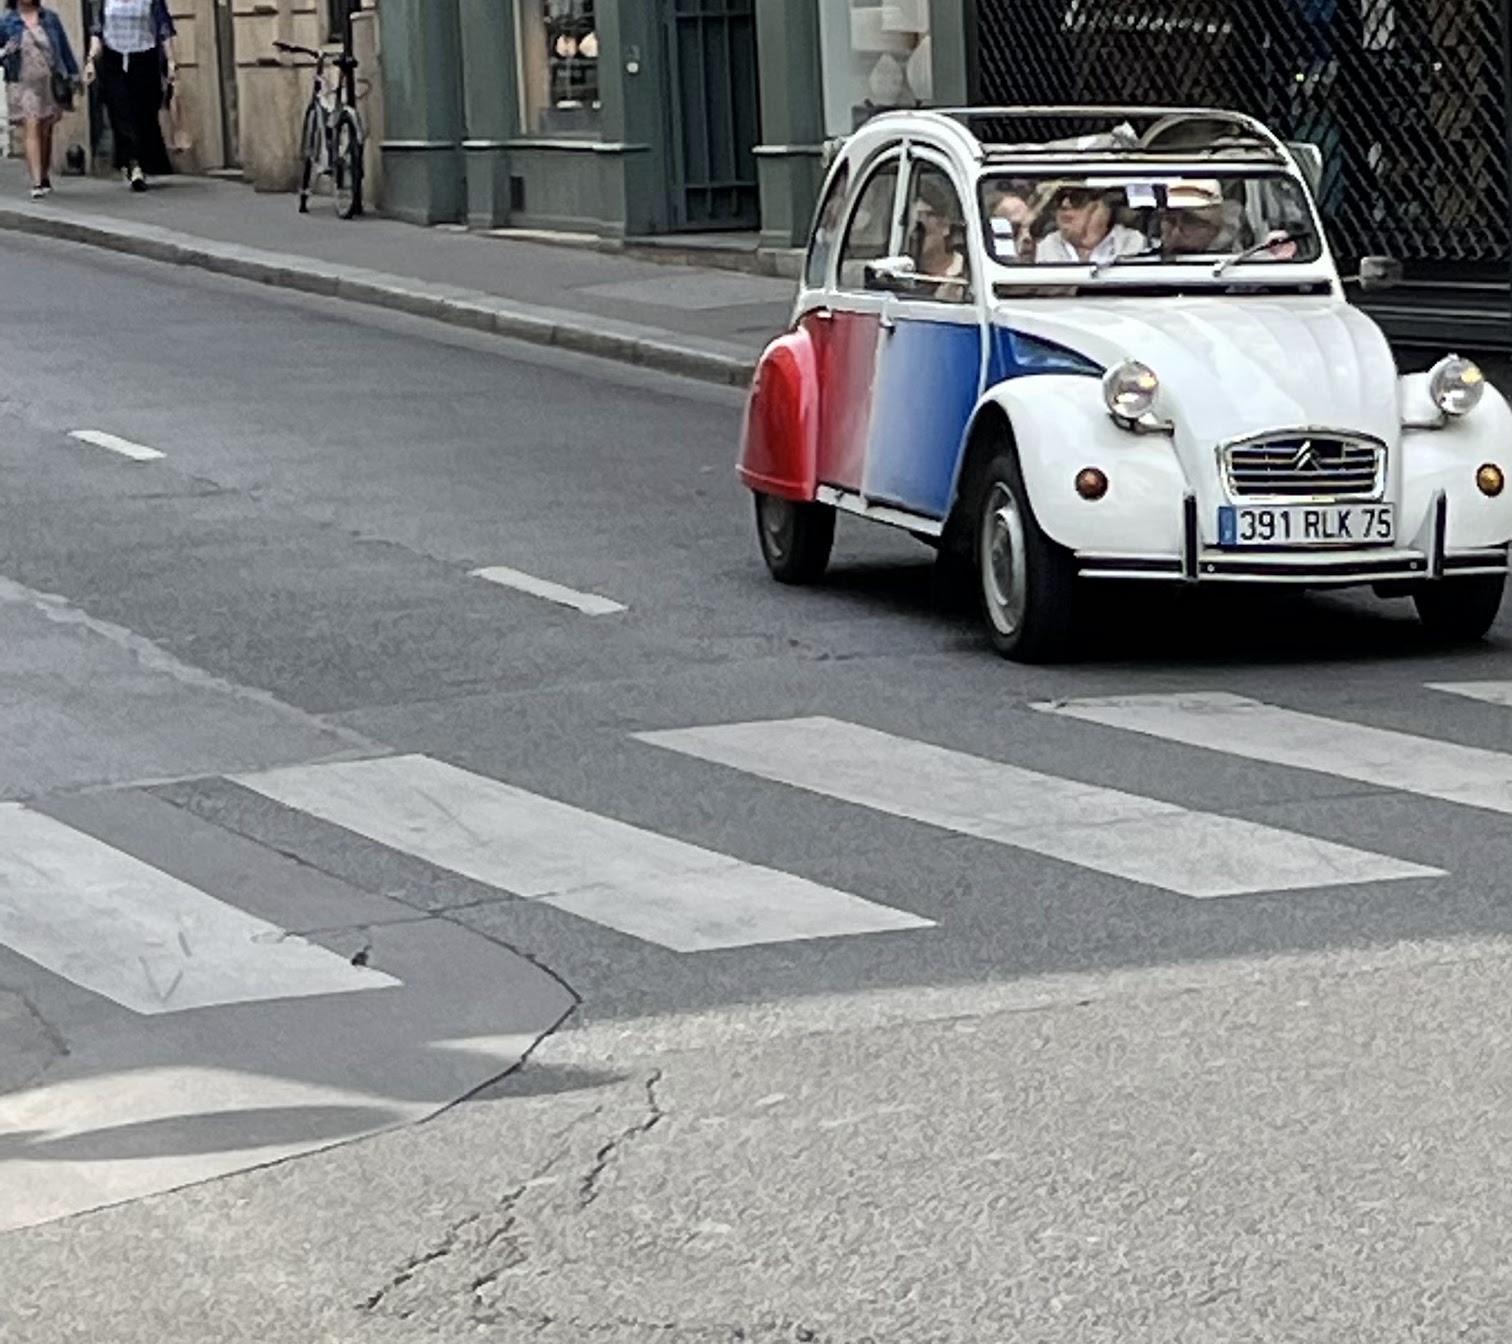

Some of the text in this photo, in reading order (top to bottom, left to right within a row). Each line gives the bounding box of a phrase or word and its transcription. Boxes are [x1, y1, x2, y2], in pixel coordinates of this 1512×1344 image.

[1240, 508, 1391, 540] 391 RLK 75
